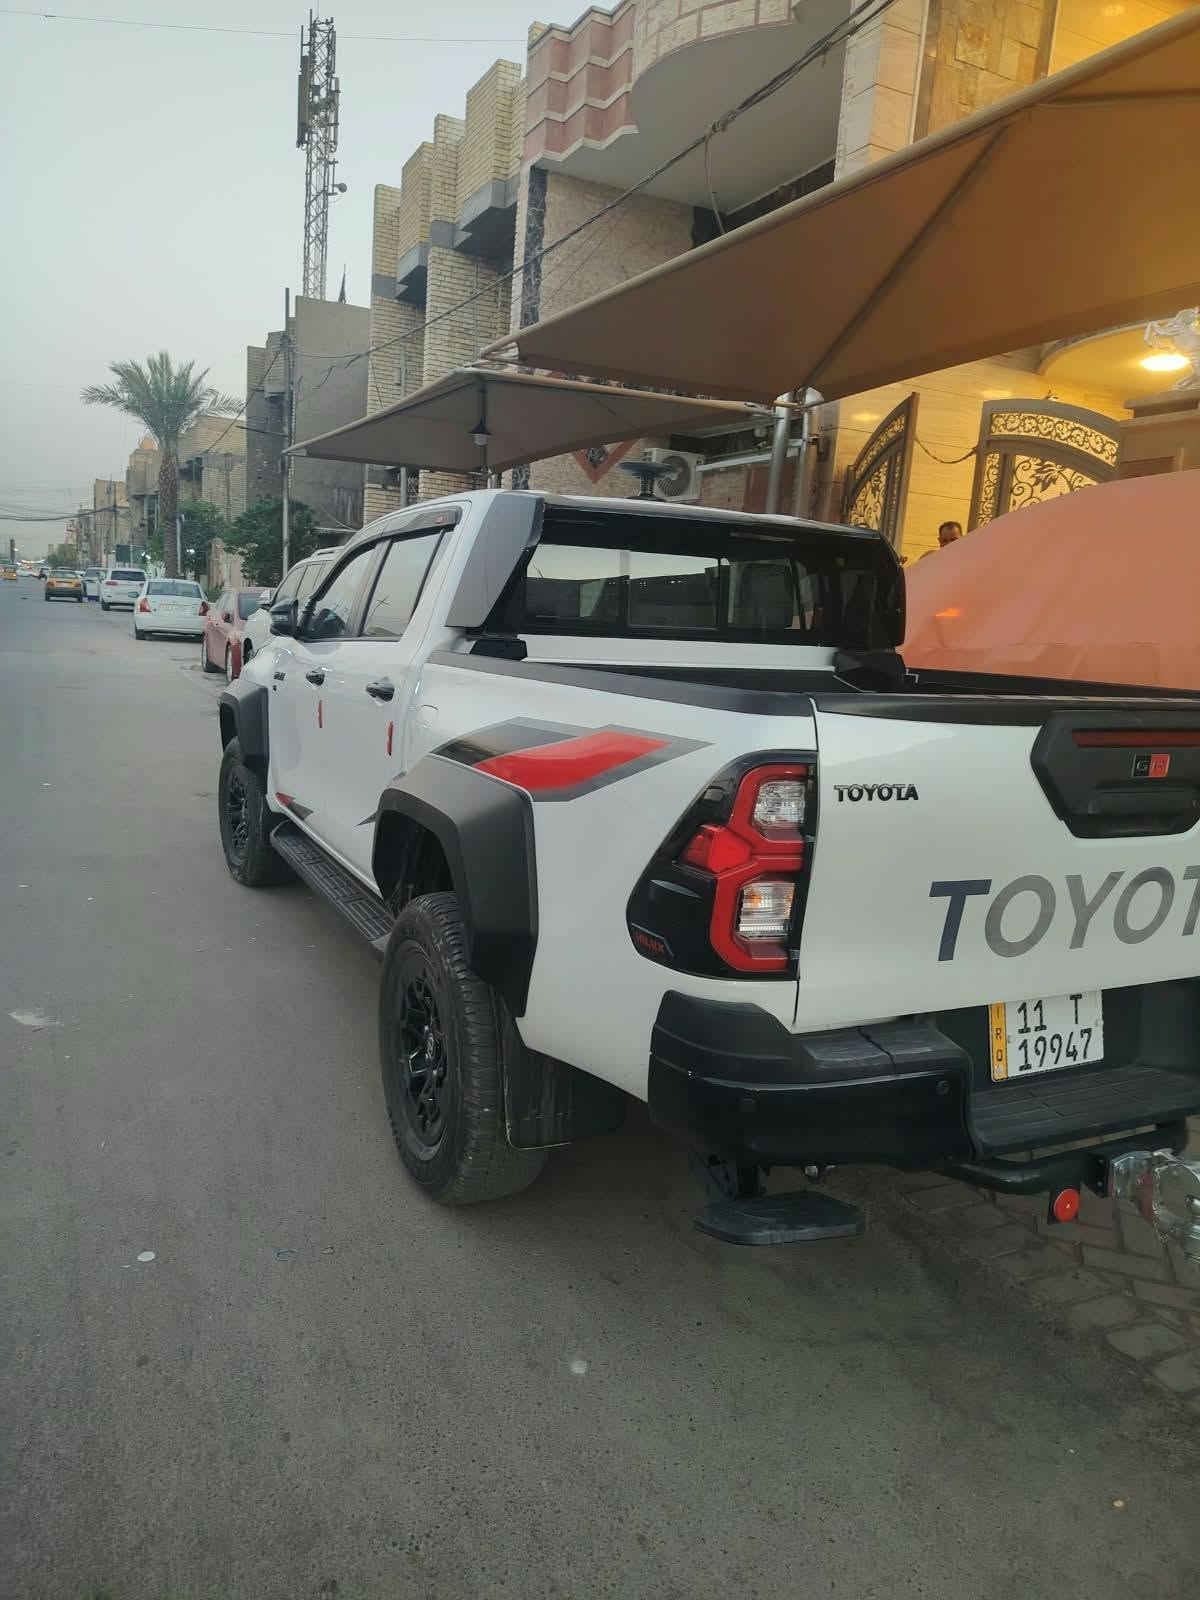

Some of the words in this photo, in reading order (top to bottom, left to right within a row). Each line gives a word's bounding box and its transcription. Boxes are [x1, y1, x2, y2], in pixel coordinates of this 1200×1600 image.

[833, 783, 919, 802] TOYOTA
[1017, 999, 1047, 1034] 11
[1069, 994, 1083, 1025] T
[1018, 1027, 1092, 1071] 19947
